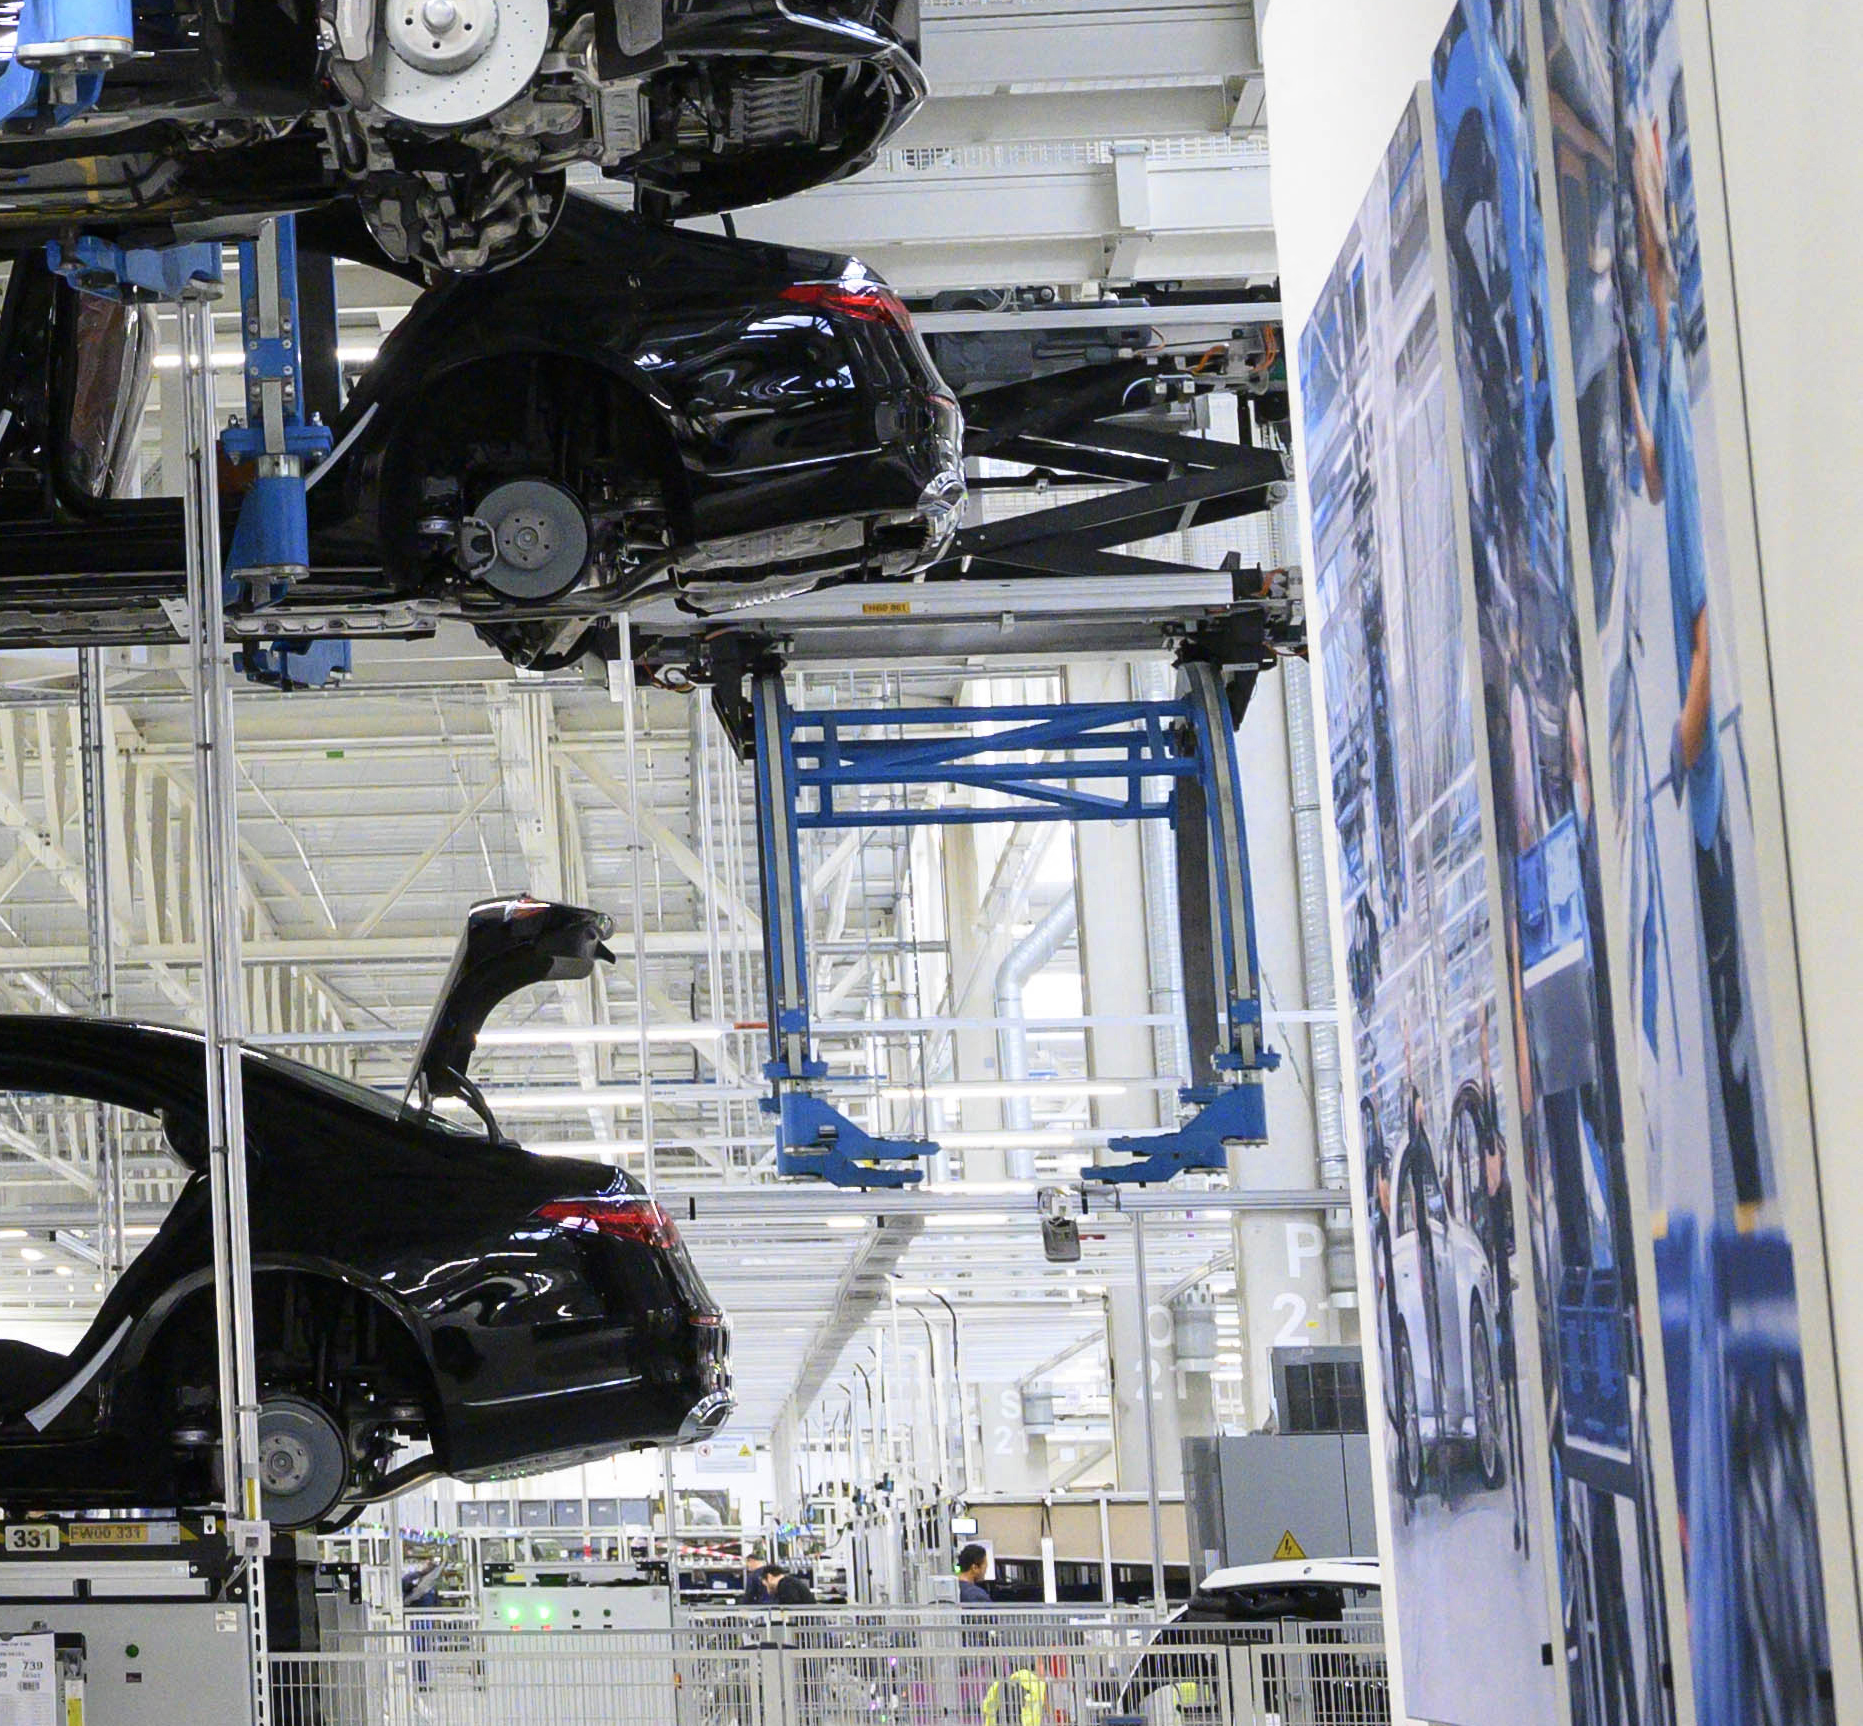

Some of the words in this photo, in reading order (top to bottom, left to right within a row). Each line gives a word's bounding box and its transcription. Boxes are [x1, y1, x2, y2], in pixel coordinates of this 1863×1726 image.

[1285, 1222, 1325, 1278] P
[1000, 1389, 1021, 1419] S
[13, 1528, 52, 1549] 331
[116, 1526, 141, 1539] 331
